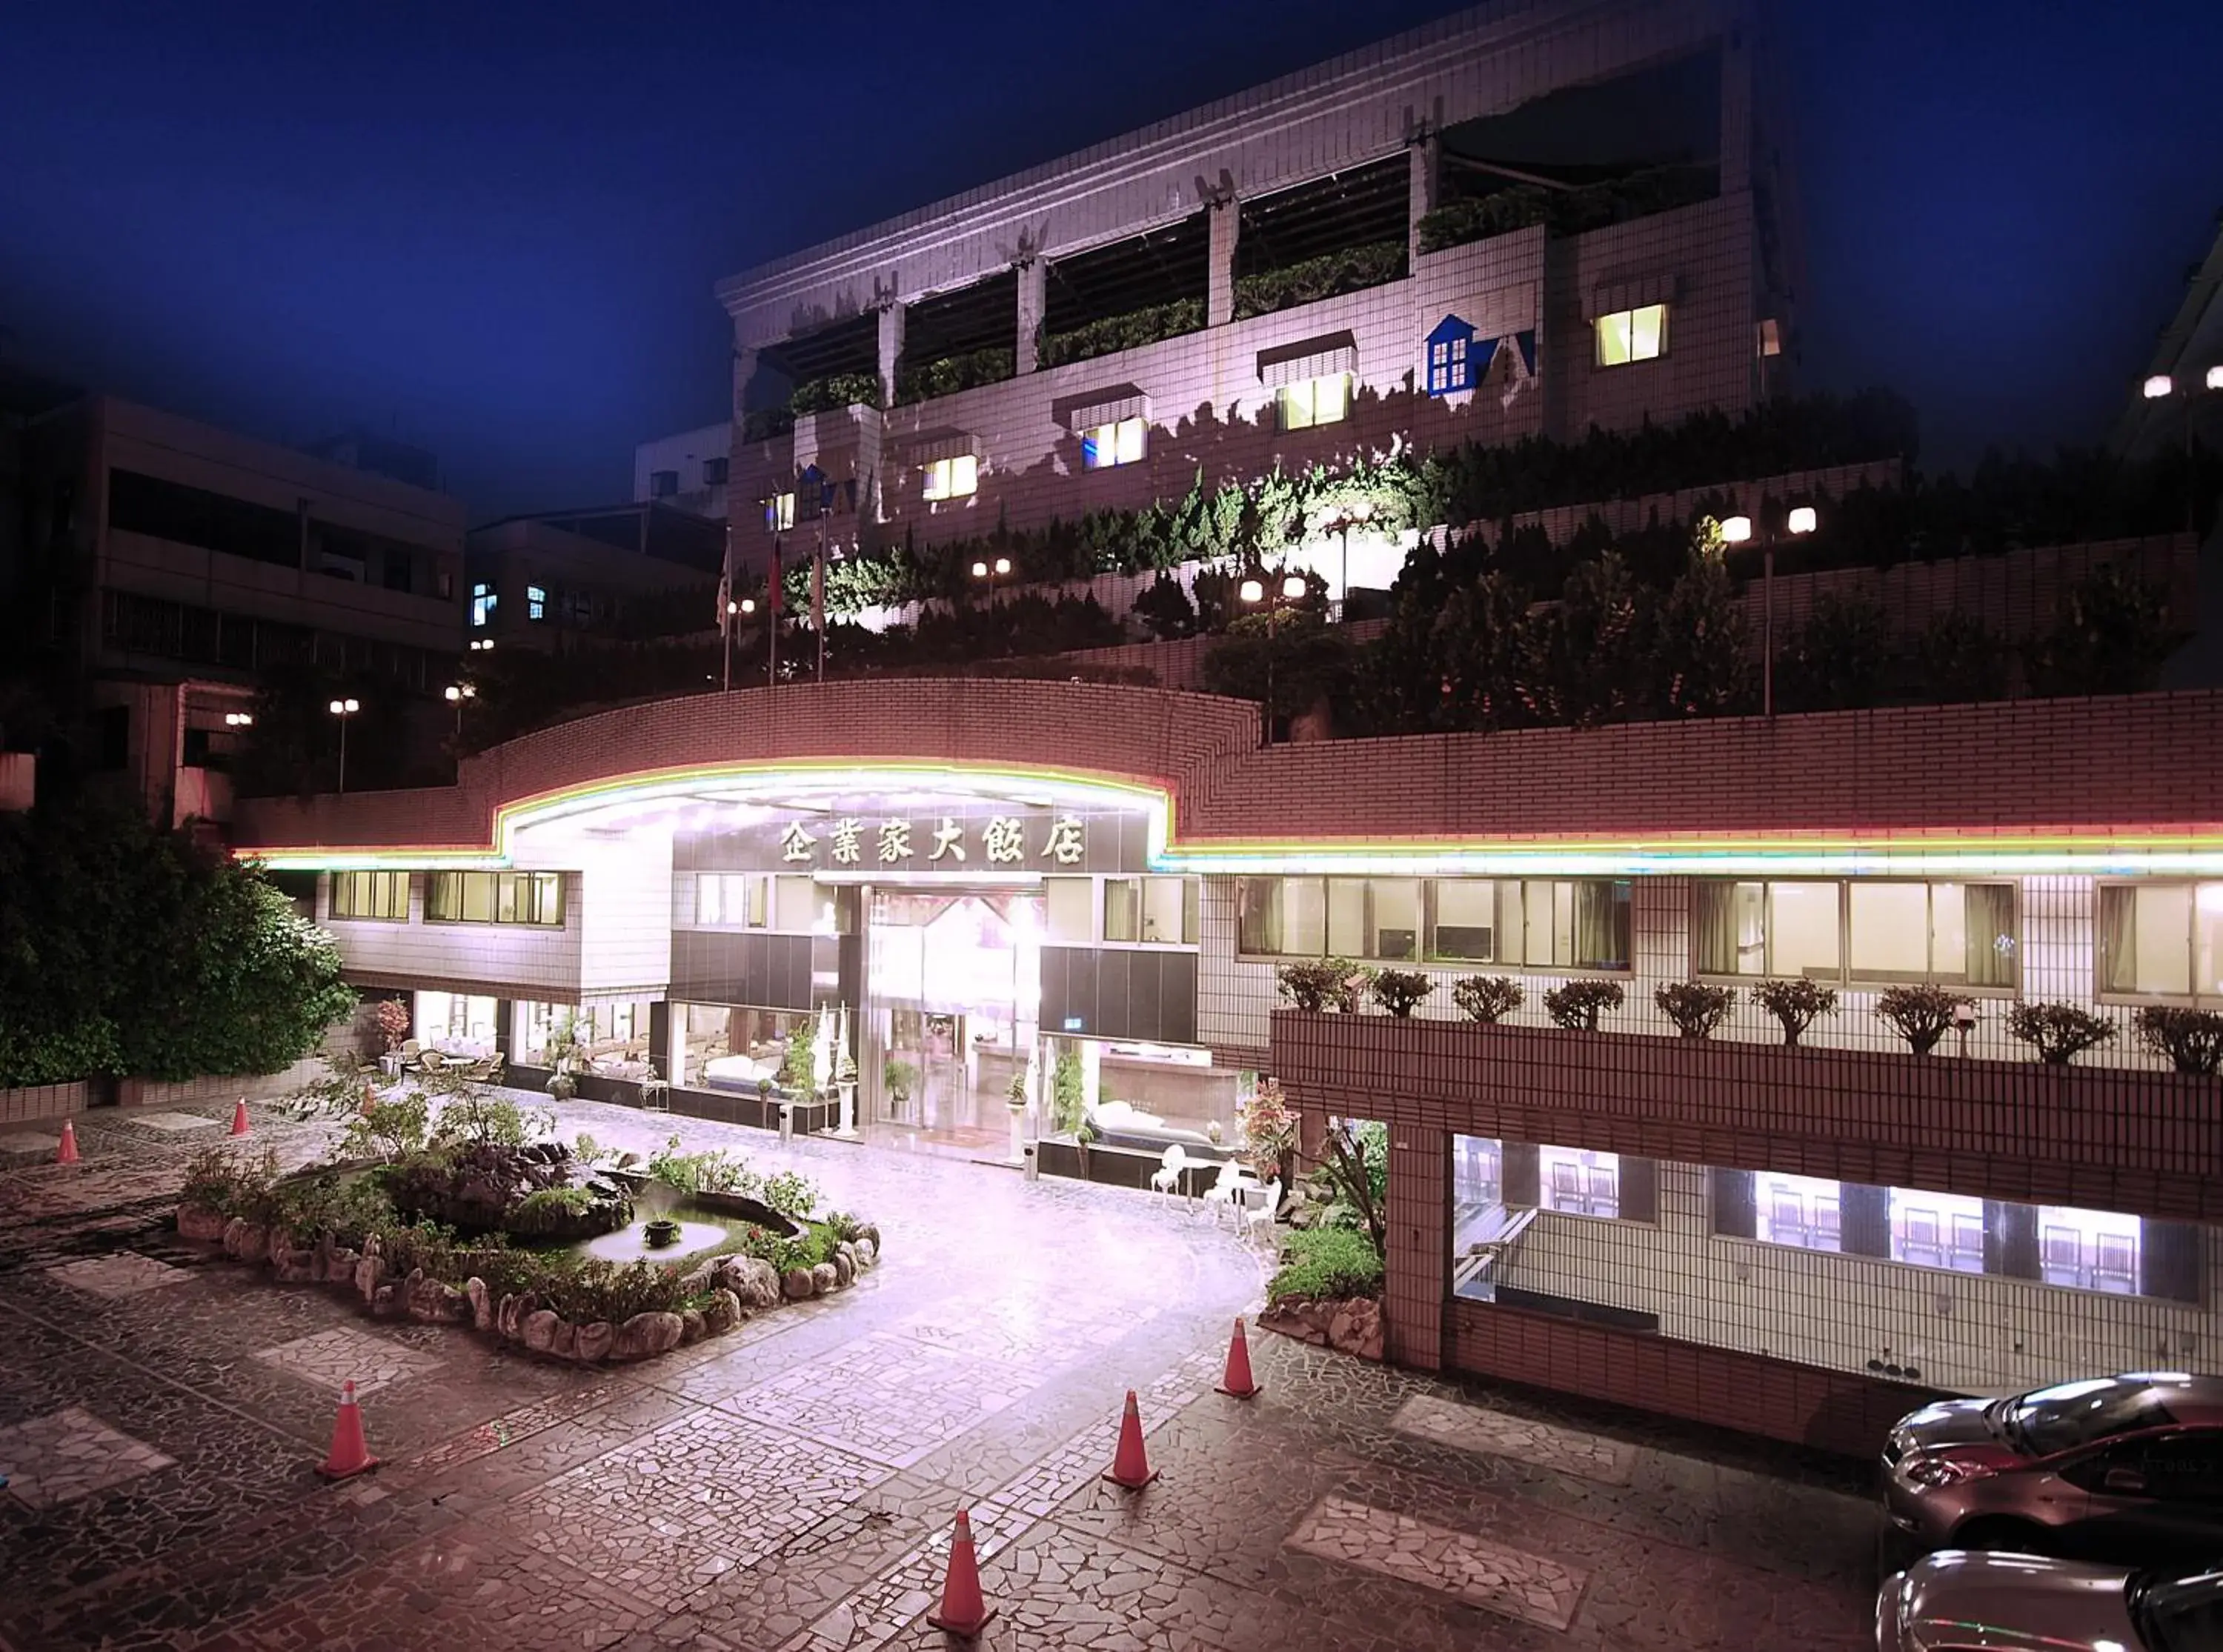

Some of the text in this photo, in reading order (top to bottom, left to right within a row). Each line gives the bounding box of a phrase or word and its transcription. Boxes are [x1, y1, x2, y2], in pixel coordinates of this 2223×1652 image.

[780, 816, 1085, 865] 企業家大飯店
